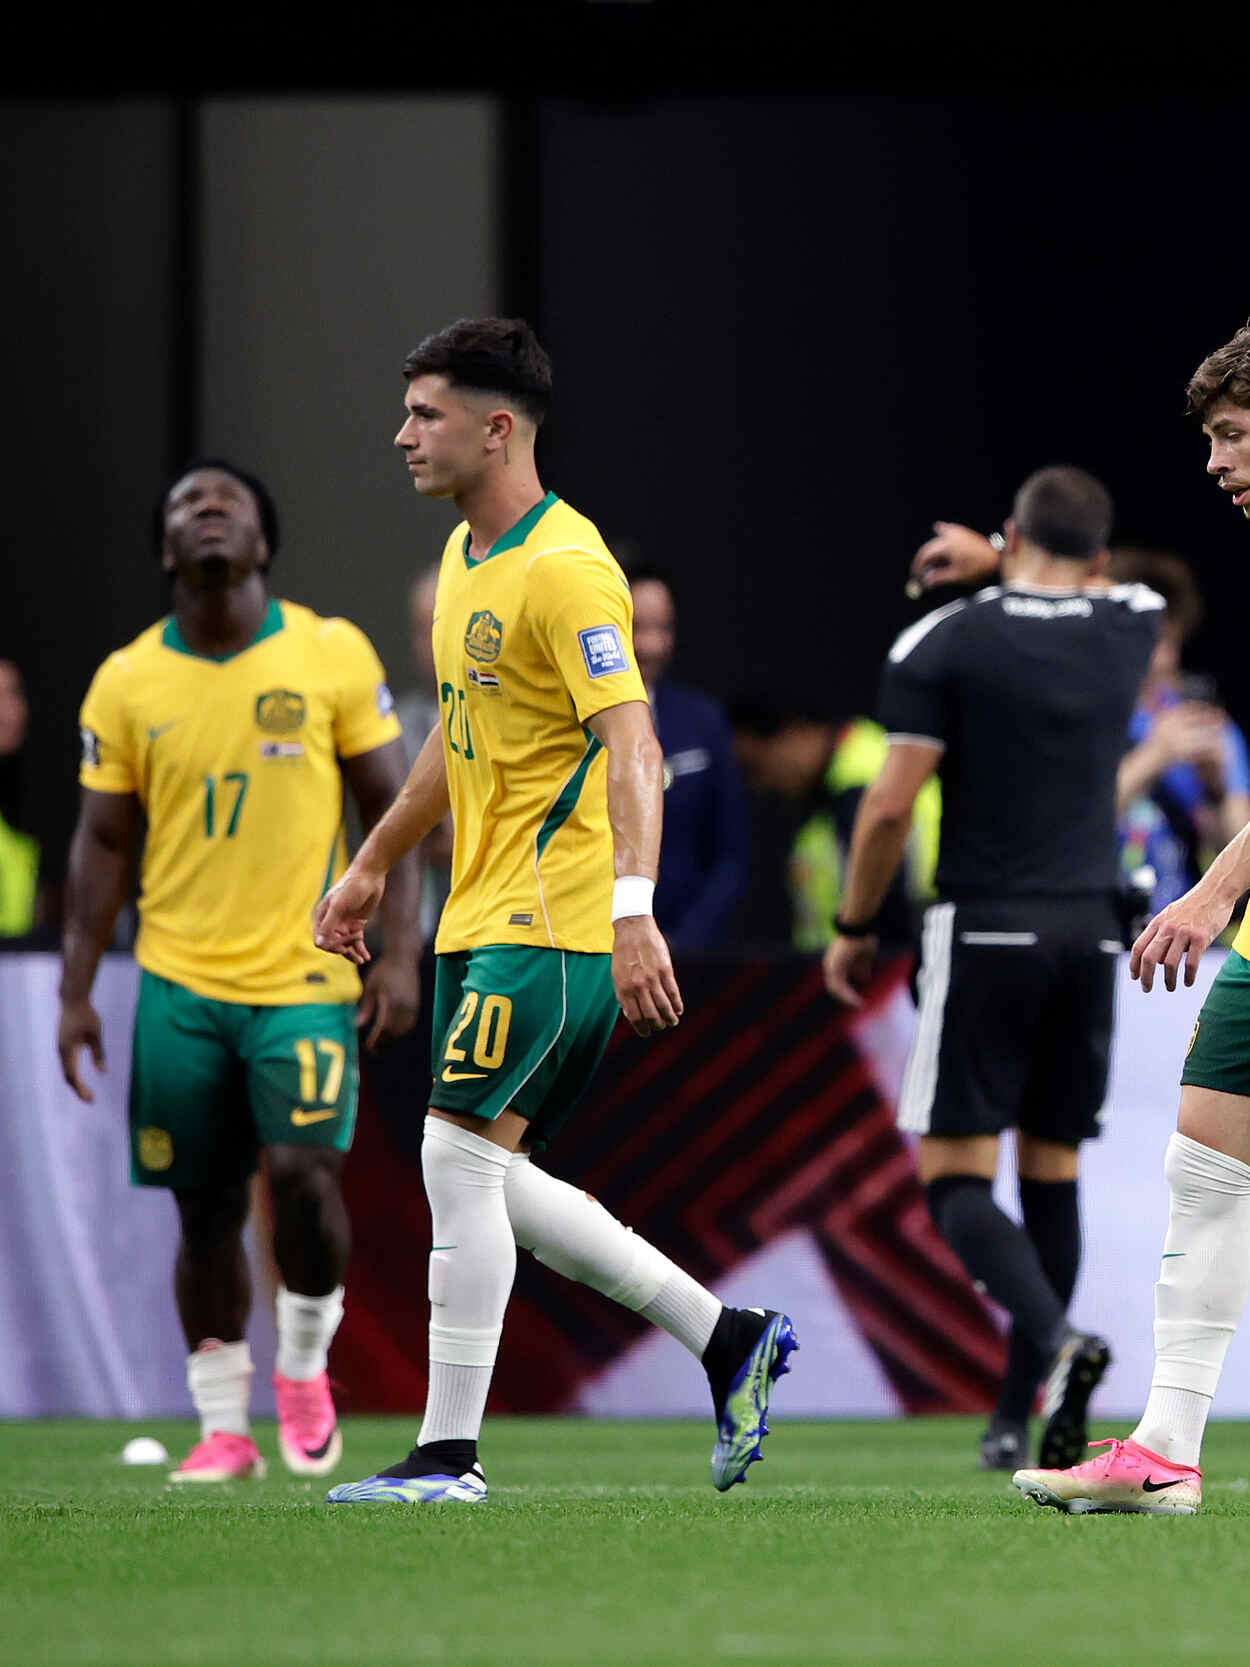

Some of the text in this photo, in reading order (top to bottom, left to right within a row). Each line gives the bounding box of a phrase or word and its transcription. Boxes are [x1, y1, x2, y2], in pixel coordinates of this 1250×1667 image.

[205, 772, 249, 838] 17
[444, 991, 513, 1069] 20
[294, 1037, 345, 1103] 17
